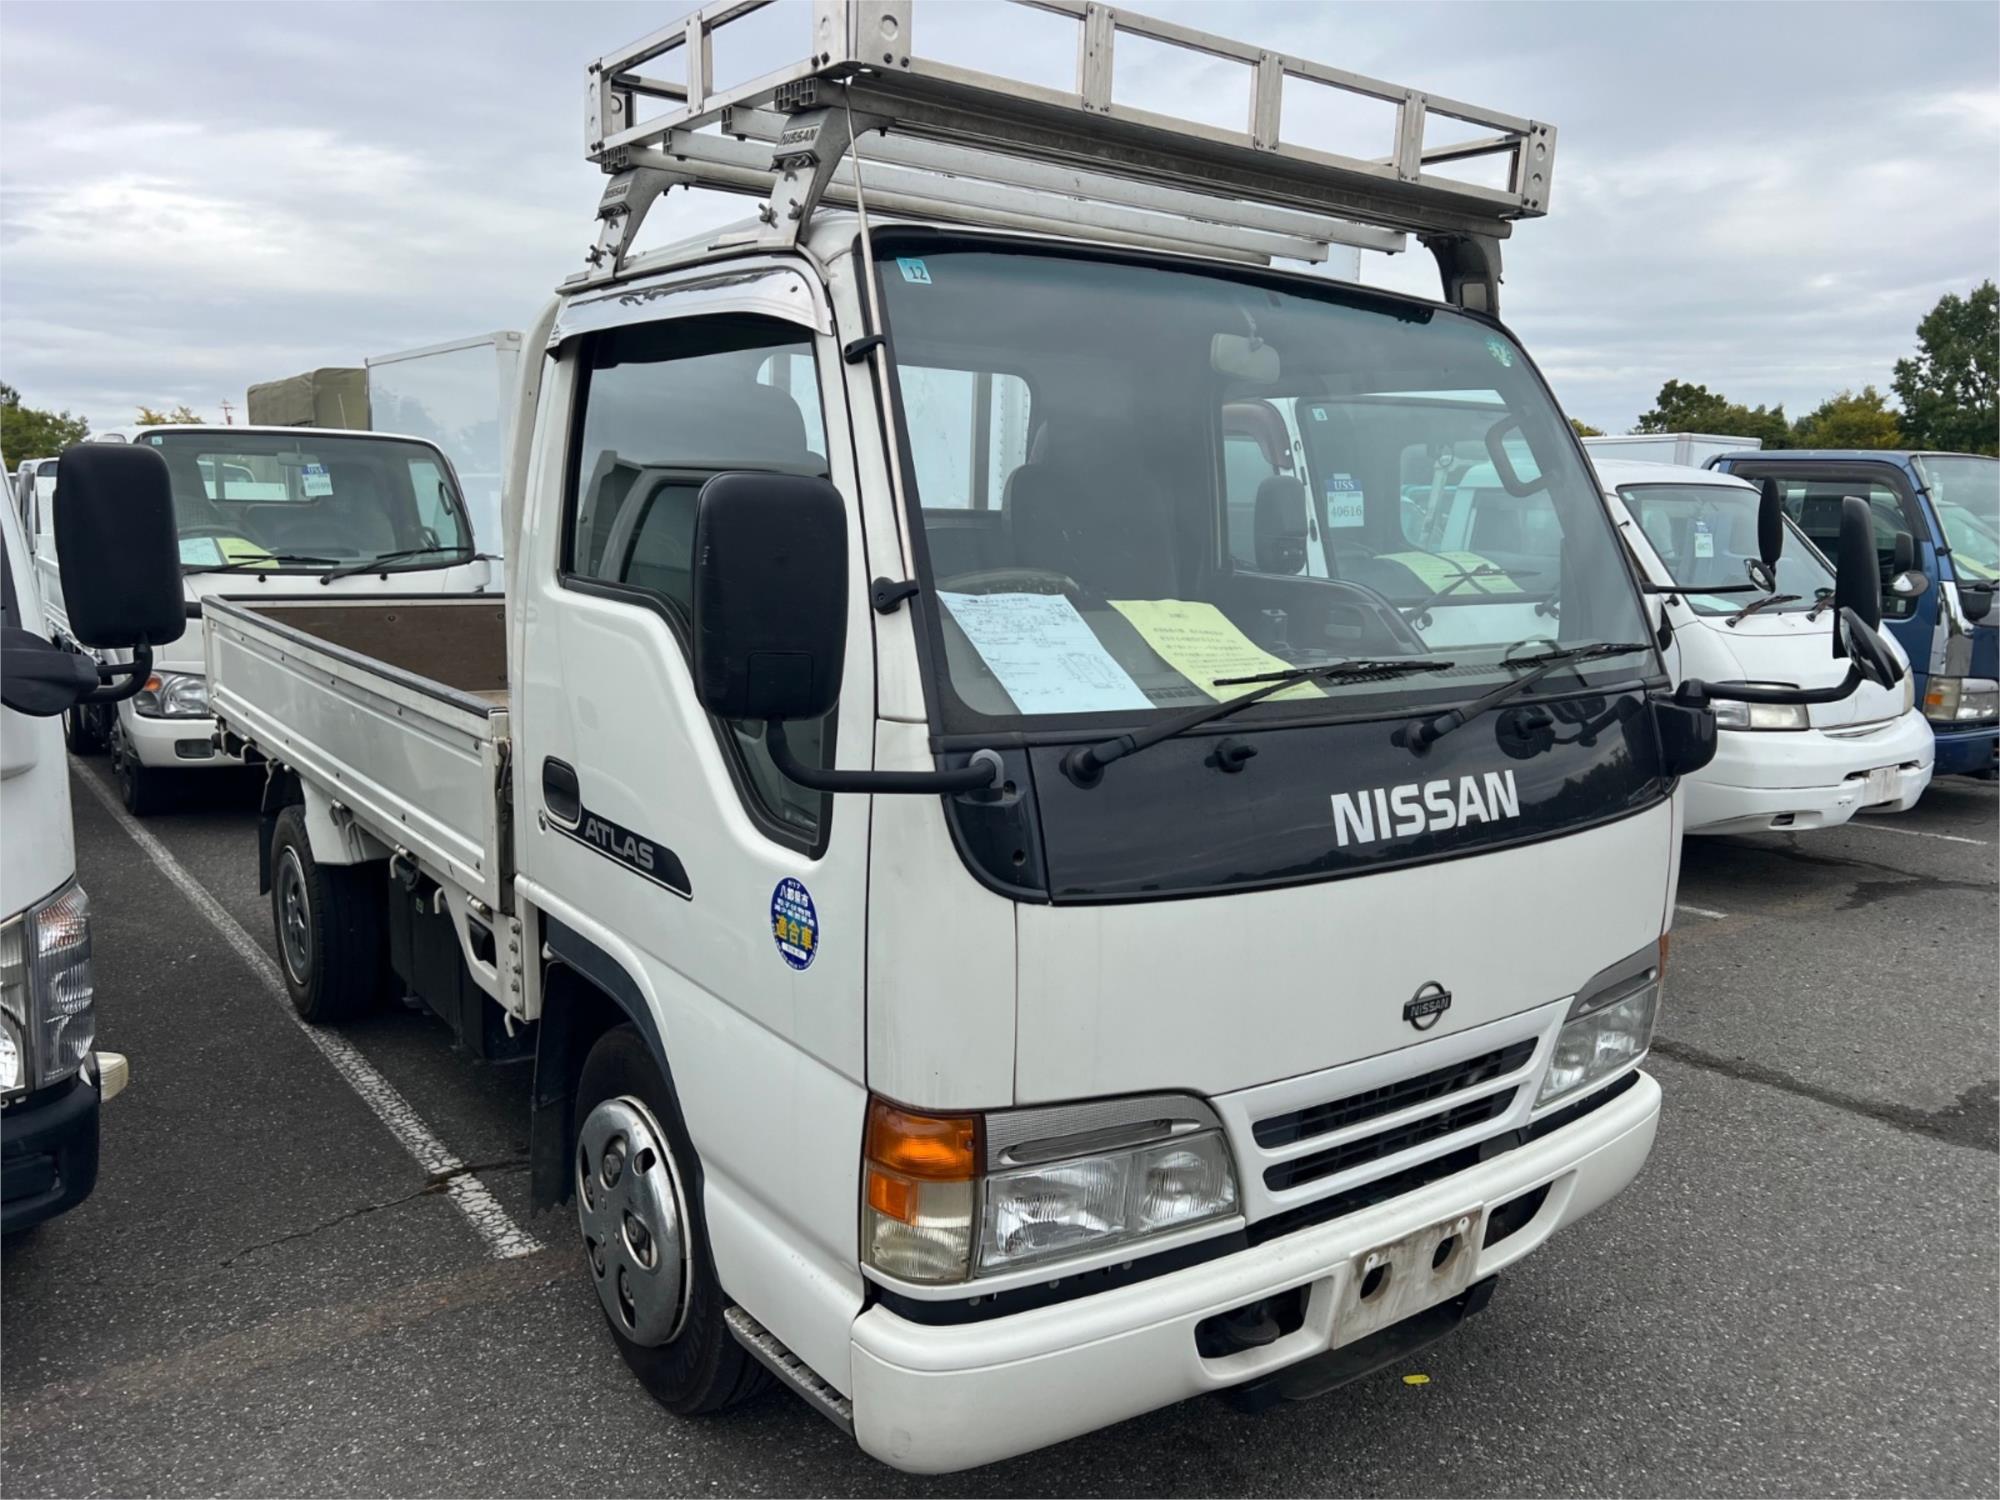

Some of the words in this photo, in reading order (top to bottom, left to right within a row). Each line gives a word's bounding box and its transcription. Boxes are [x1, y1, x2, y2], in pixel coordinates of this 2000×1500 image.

[782, 127, 819, 146] NISSAN
[909, 265, 927, 280] 12
[1333, 480, 1355, 491] USS
[1330, 769, 1521, 848] NISSAN
[585, 817, 654, 870] ATLAS
[1410, 996, 1449, 1017] NISSAN
